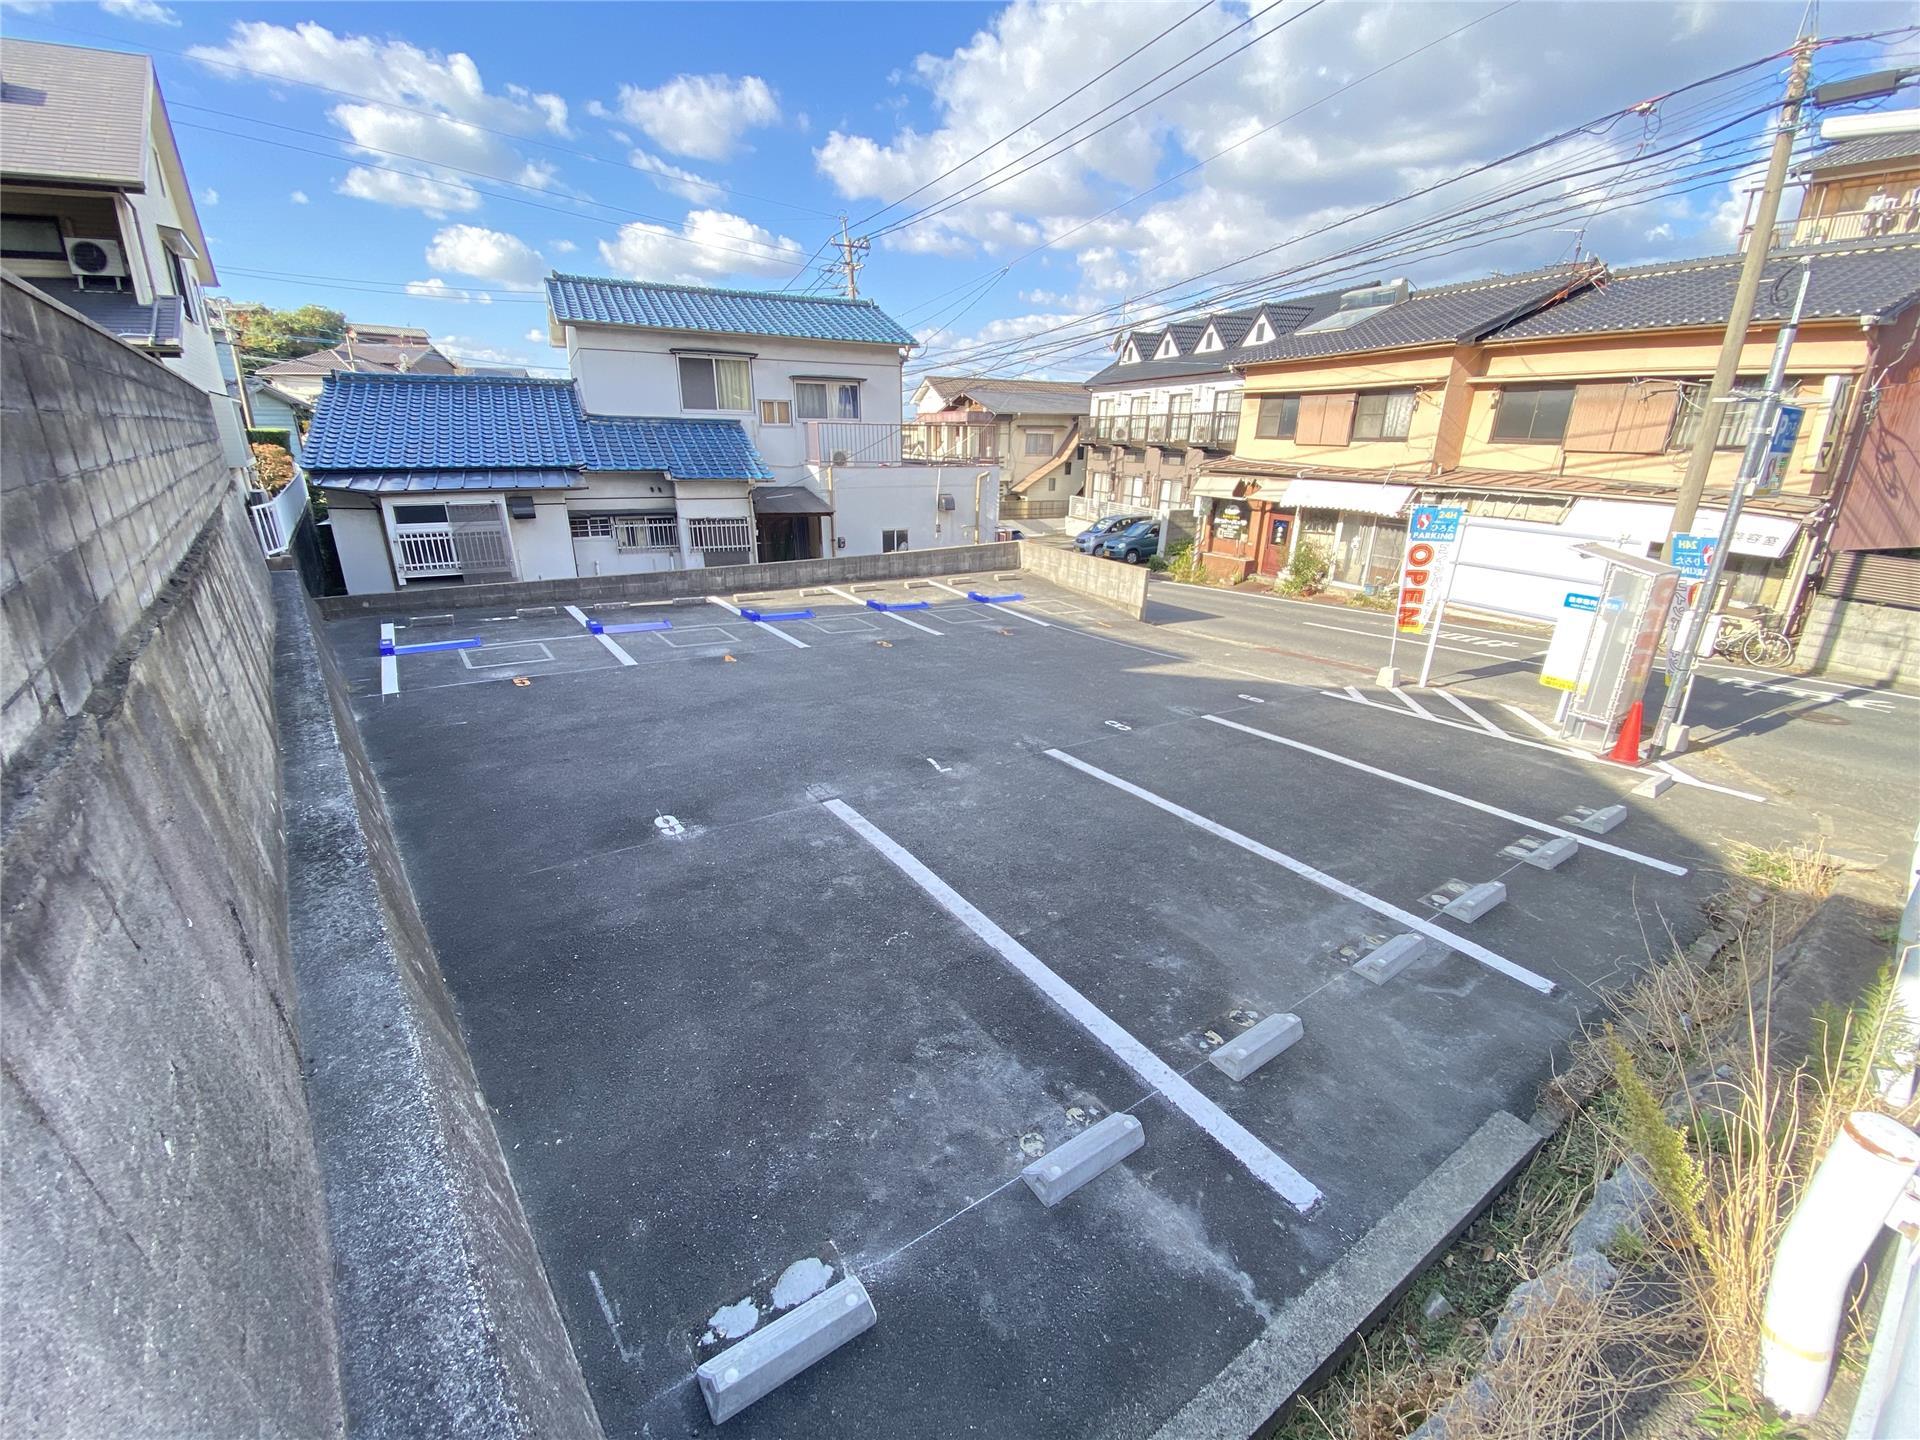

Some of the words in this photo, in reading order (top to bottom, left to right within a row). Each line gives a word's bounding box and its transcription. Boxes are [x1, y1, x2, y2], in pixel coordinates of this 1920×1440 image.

[1438, 510, 1459, 519] 24H
[1412, 531, 1455, 540] PARKING
[1398, 543, 1435, 627] OPEN
